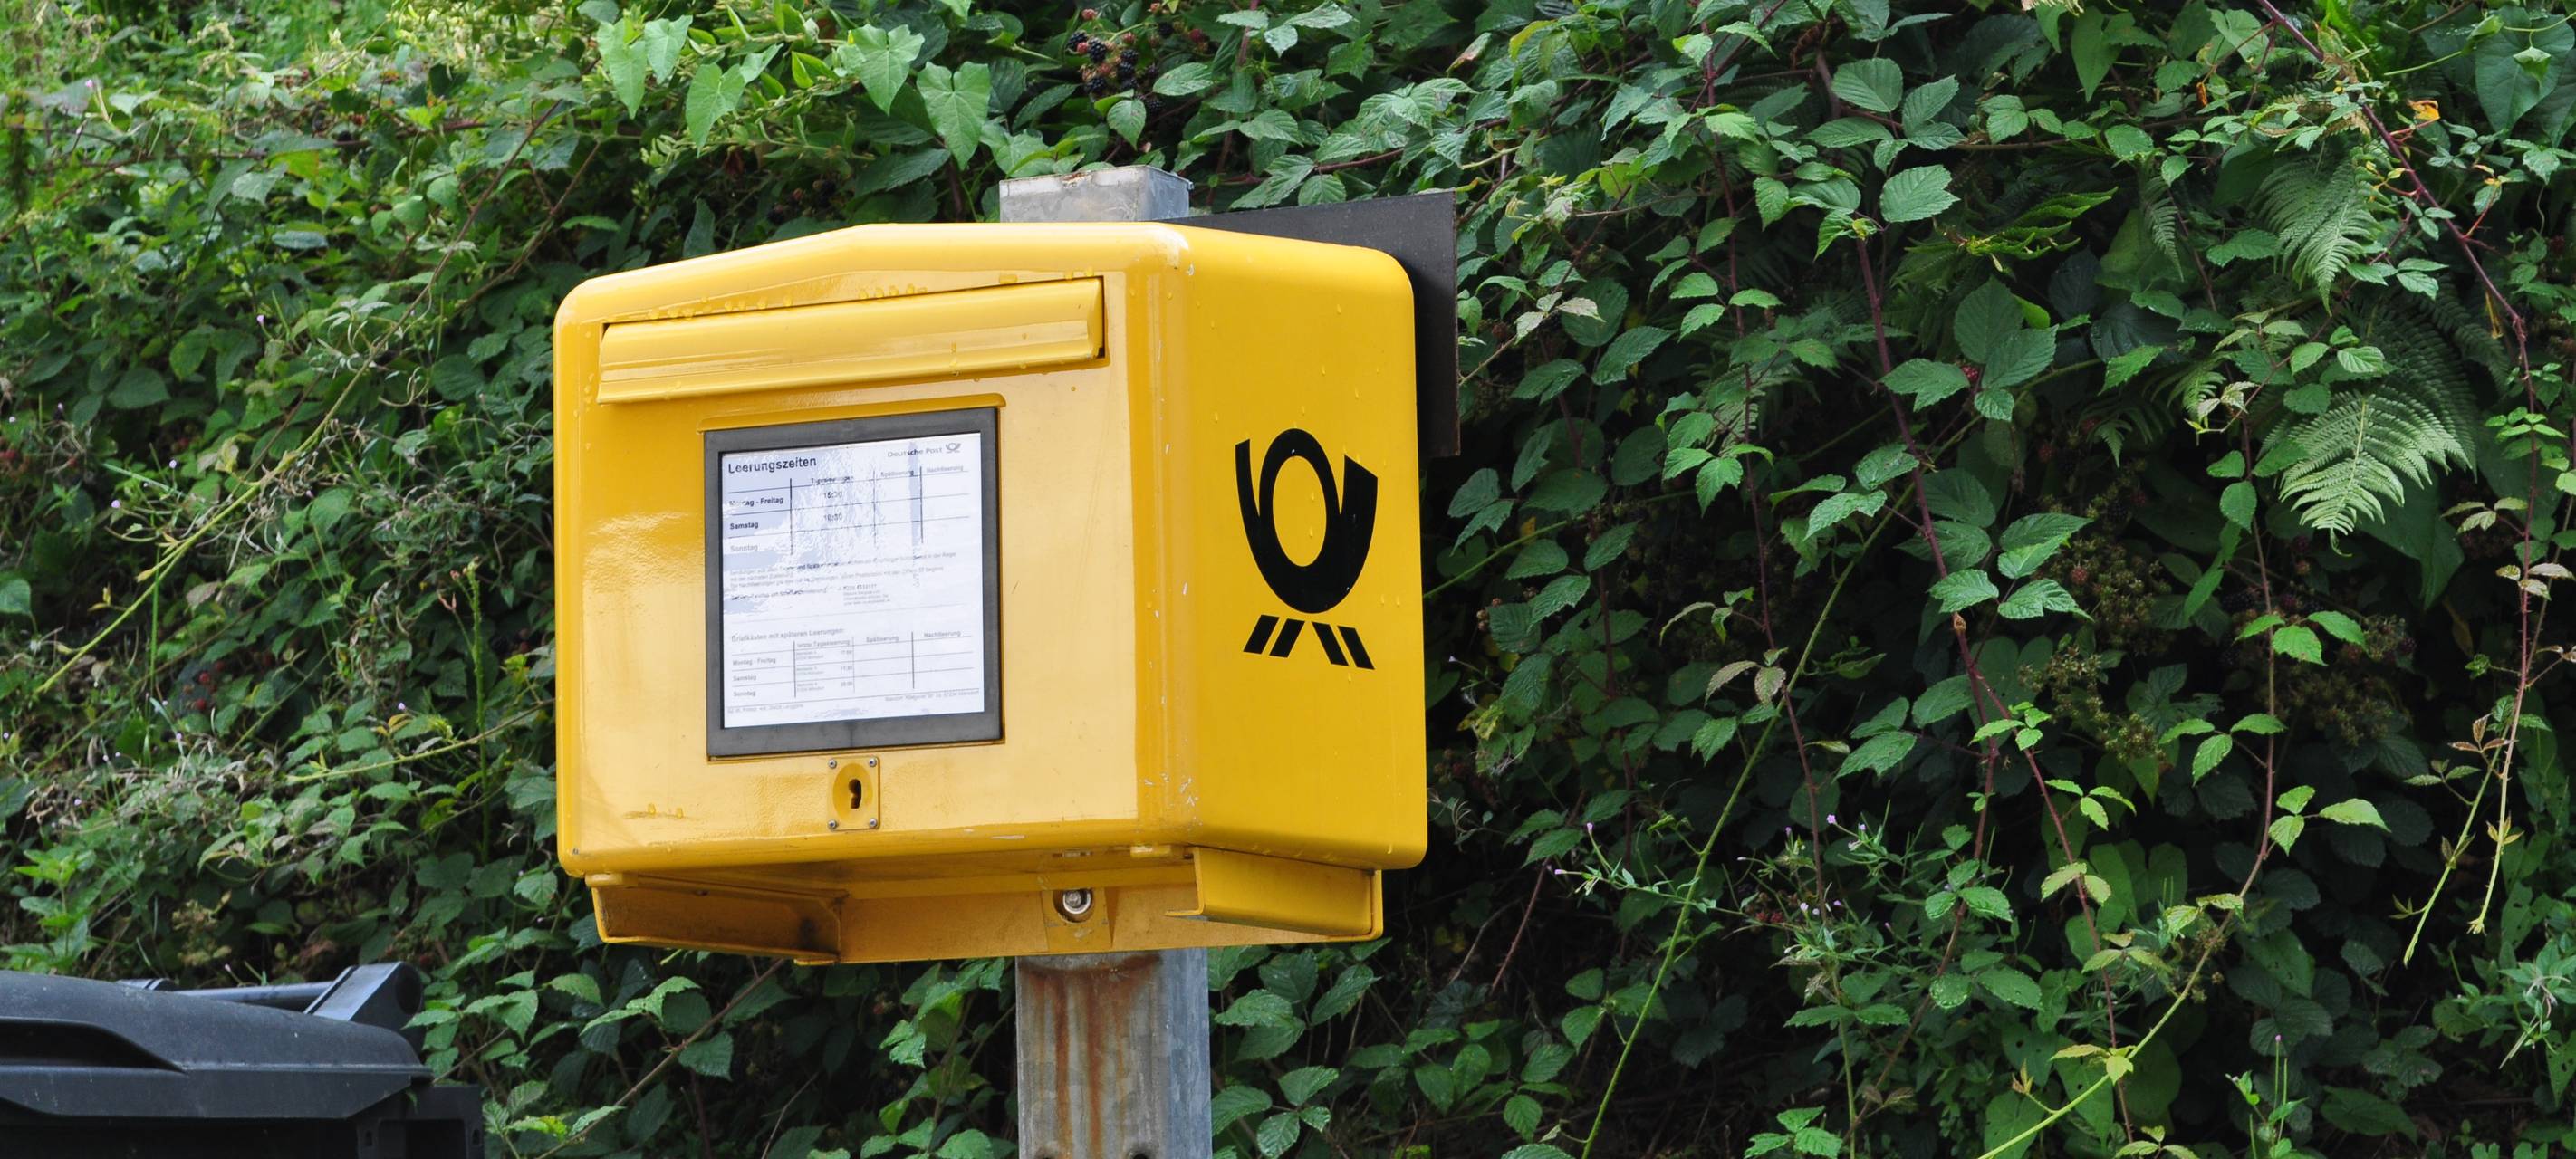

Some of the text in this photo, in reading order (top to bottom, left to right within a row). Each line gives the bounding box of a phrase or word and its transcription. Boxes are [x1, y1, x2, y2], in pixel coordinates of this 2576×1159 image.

[888, 448, 924, 457] Deutsche
[728, 457, 817, 473] Leerungszeiten
[760, 498, 783, 506] Freitag
[730, 522, 759, 530] Samstag
